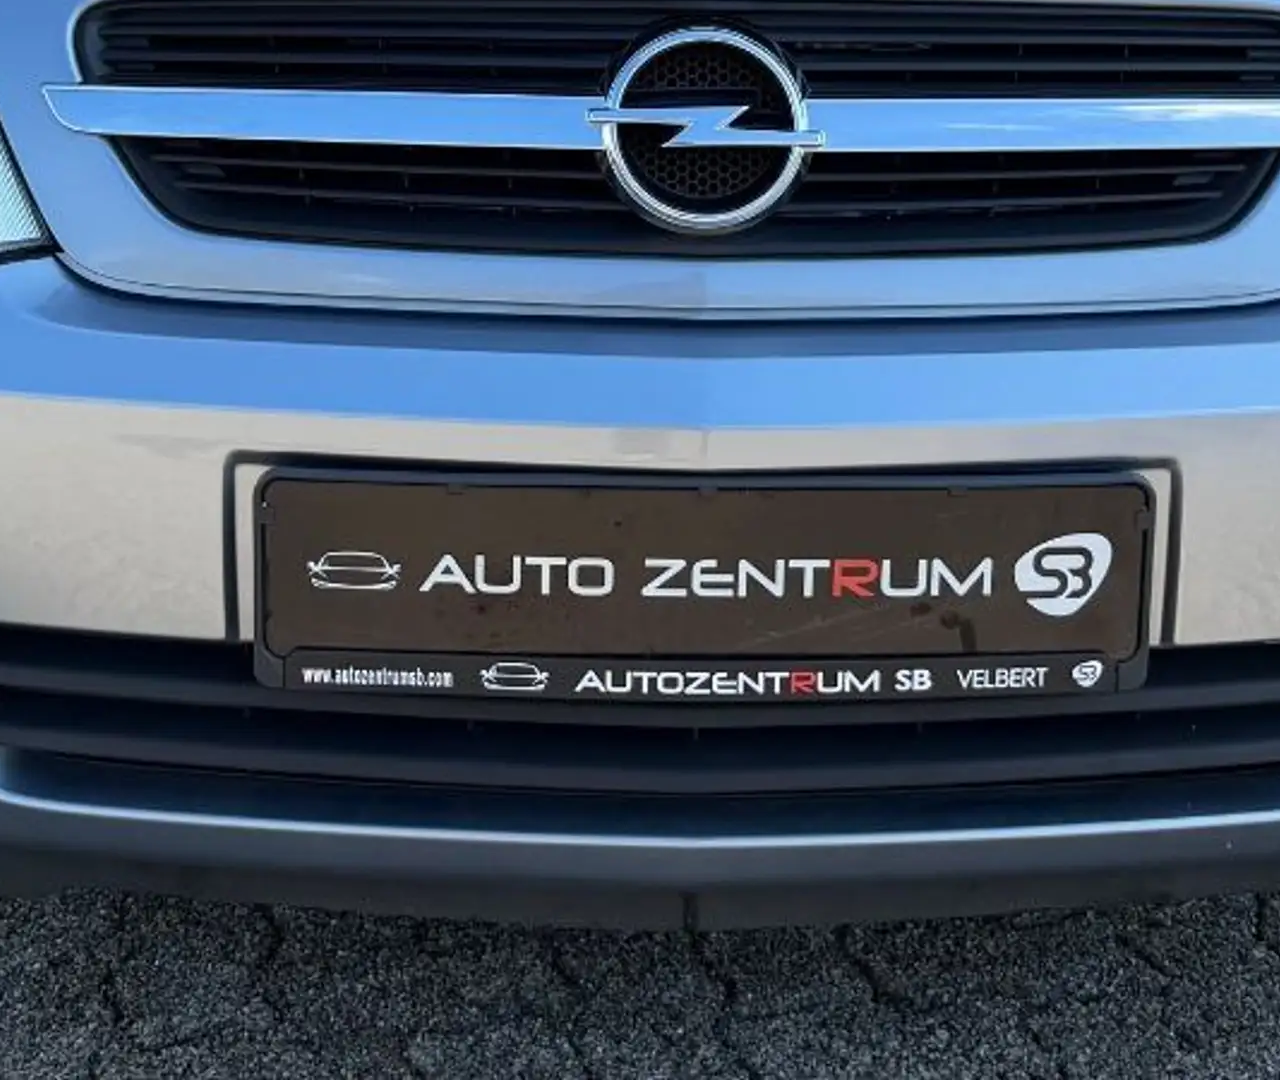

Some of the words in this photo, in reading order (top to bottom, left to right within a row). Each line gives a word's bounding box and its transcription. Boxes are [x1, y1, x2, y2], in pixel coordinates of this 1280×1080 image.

[419, 554, 615, 597] AUTO
[640, 557, 994, 598] ZENTRUM
[302, 667, 454, 688] www.autozentrumsb.com
[575, 670, 881, 695] AUTOZENTRUM
[894, 669, 931, 691] SB
[957, 667, 1048, 688] VELBERT
